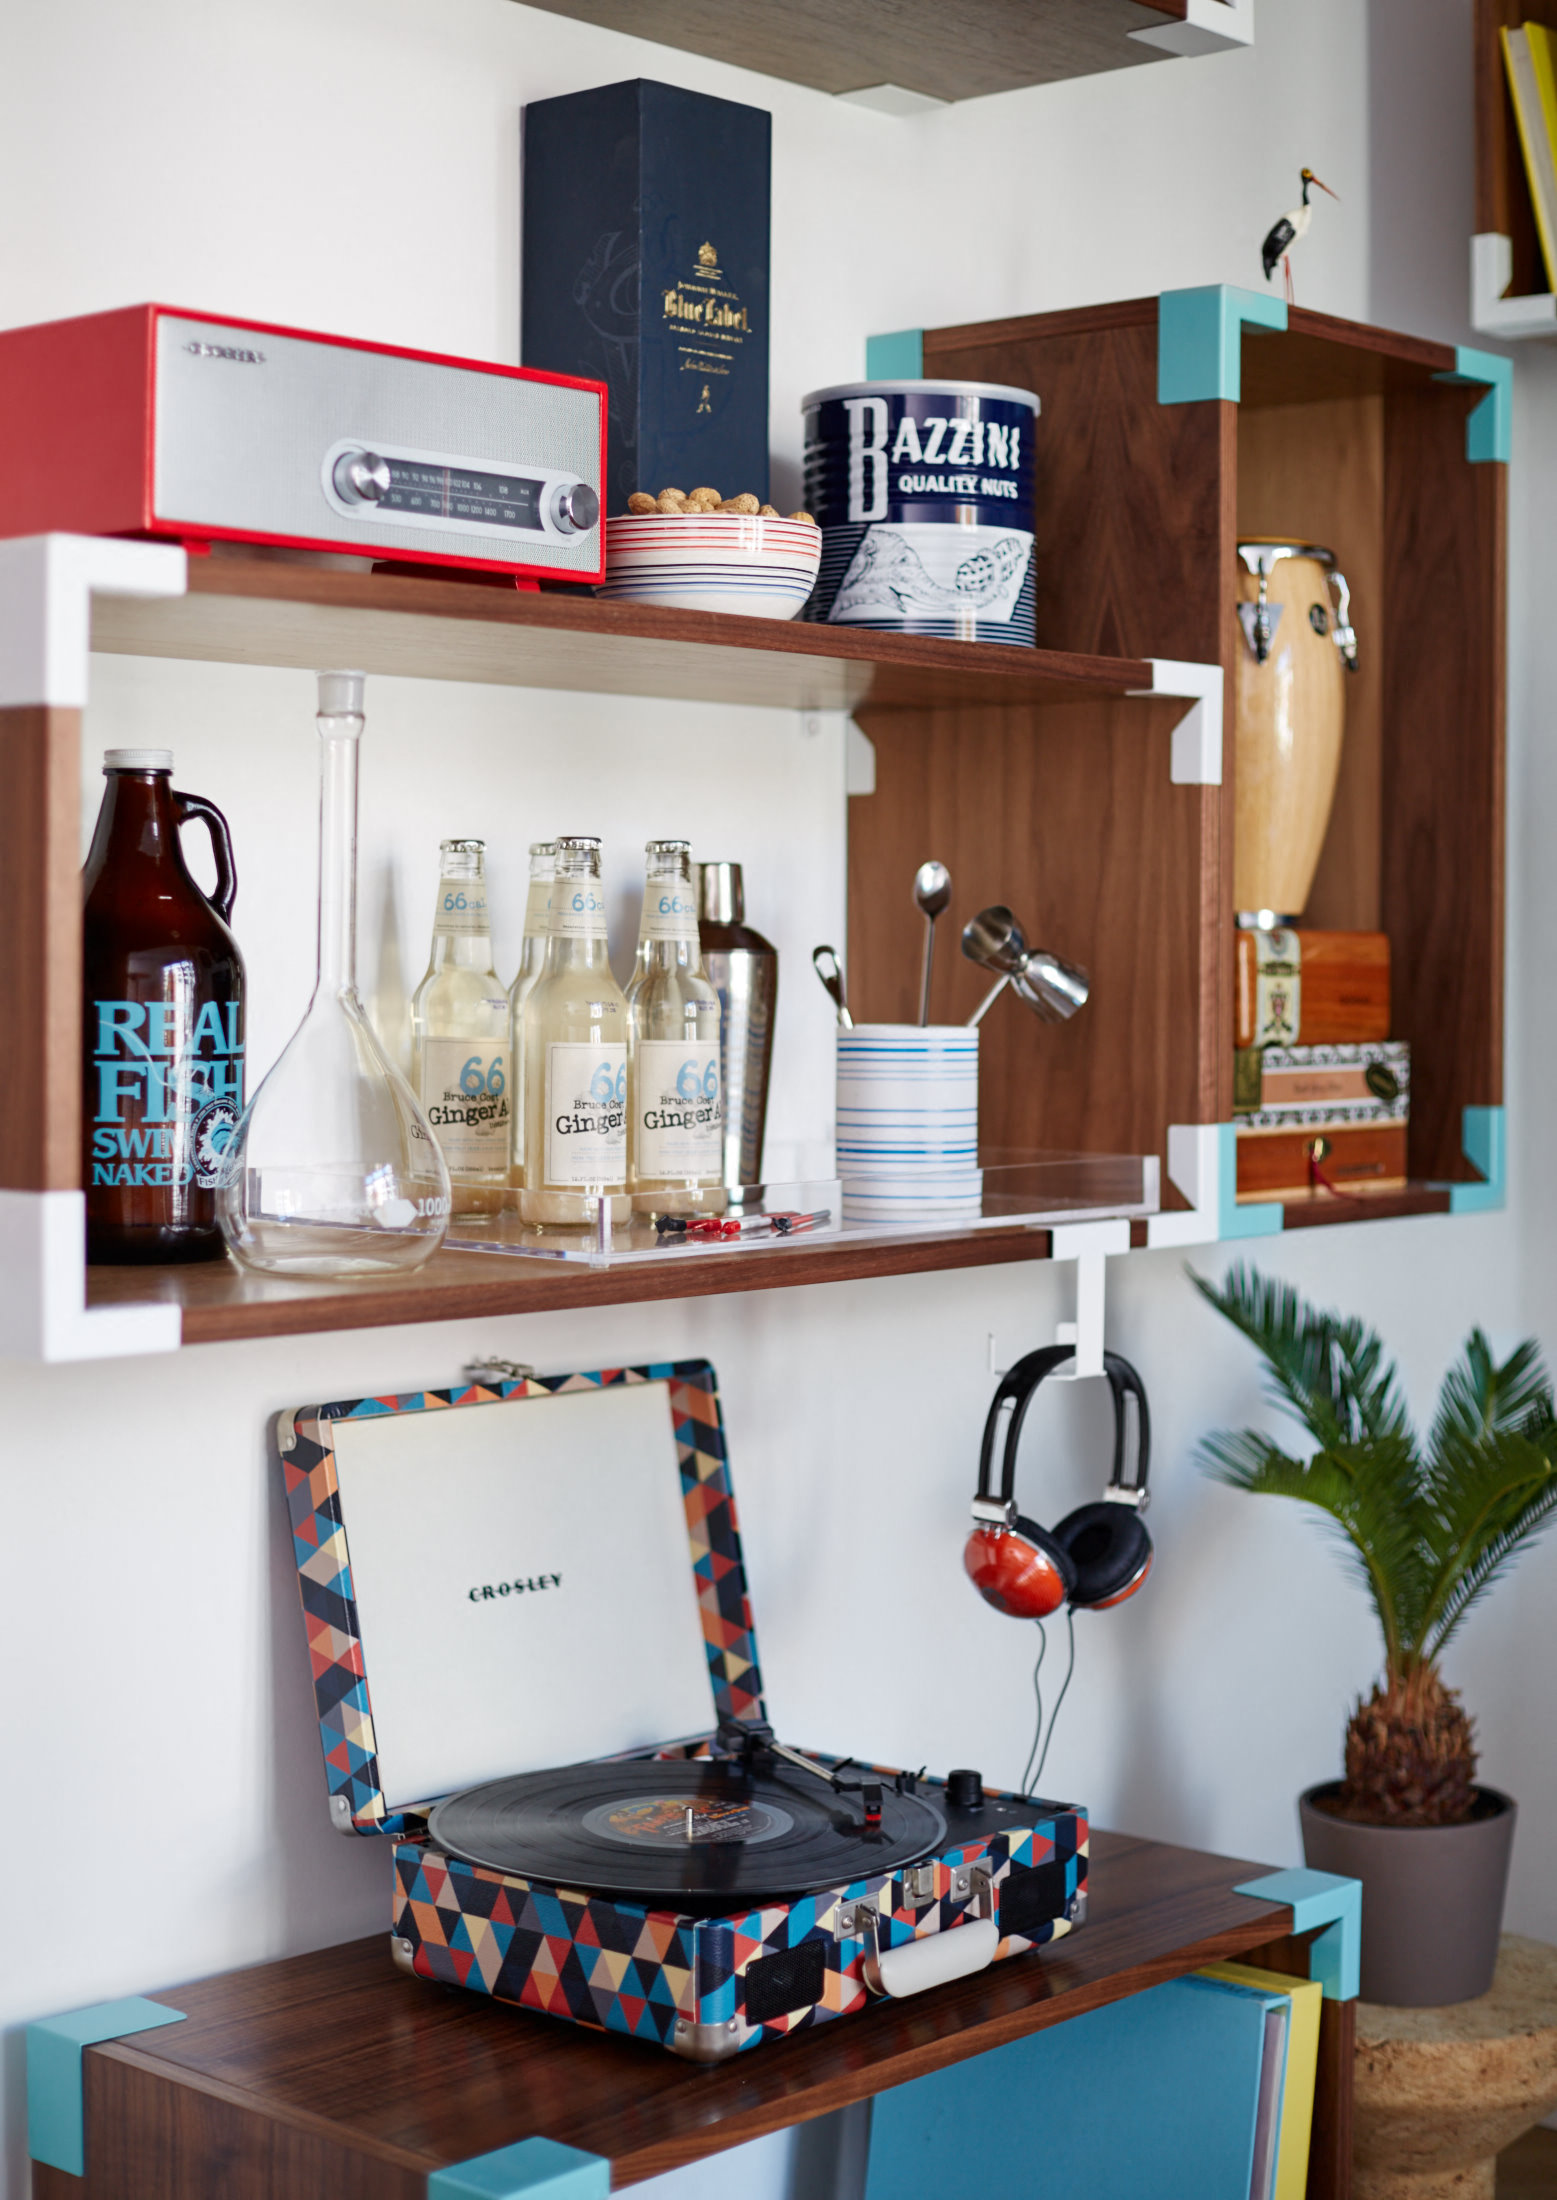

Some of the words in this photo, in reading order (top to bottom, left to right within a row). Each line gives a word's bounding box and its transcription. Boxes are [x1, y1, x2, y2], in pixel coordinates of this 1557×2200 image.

[661, 289, 703, 323] Blue
[842, 397, 1020, 521] BAZZINI
[899, 475, 977, 494] QUALITY
[981, 478, 1018, 499] NUTS
[470, 505, 483, 515] 1200
[484, 507, 497, 517] 1400
[504, 509, 516, 519] 1700
[93, 1000, 246, 1056] REAL
[459, 1056, 506, 1097] 66
[590, 1062, 626, 1103] 66
[676, 1059, 719, 1099] 66
[93, 1060, 245, 1123] FISH
[443, 1091, 477, 1102] Bruce
[660, 1095, 694, 1105] Bruce
[428, 1103, 498, 1126] Ginger
[573, 1099, 607, 1110] Bruce
[556, 1112, 624, 1135] Ginger
[643, 1107, 713, 1130] Ginger
[92, 1163, 193, 1187] NAKED
[468, 1572, 562, 1603] CROSLEY
